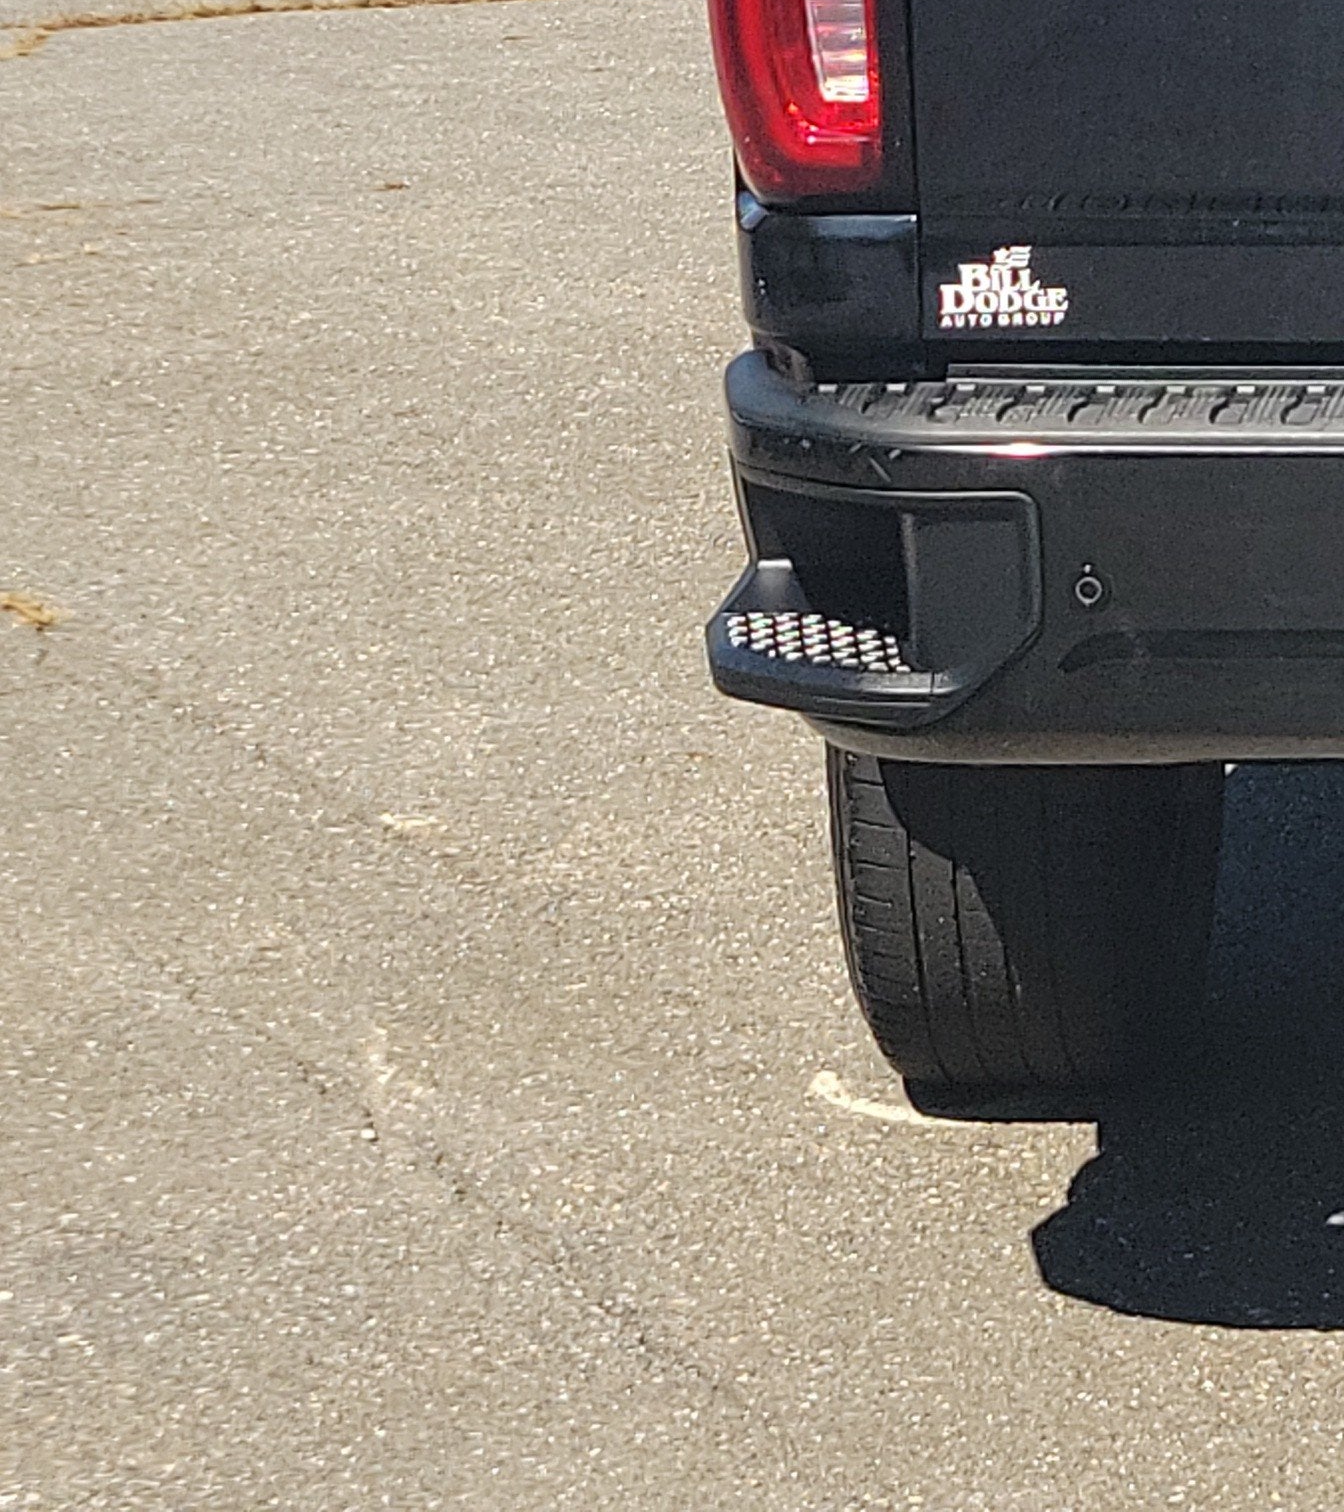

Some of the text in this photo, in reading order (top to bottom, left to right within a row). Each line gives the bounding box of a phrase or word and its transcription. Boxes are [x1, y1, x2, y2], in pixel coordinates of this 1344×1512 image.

[957, 262, 1041, 291] BILL
[939, 284, 1069, 315] DODGE
[939, 311, 1065, 329] AUTO GROUP
